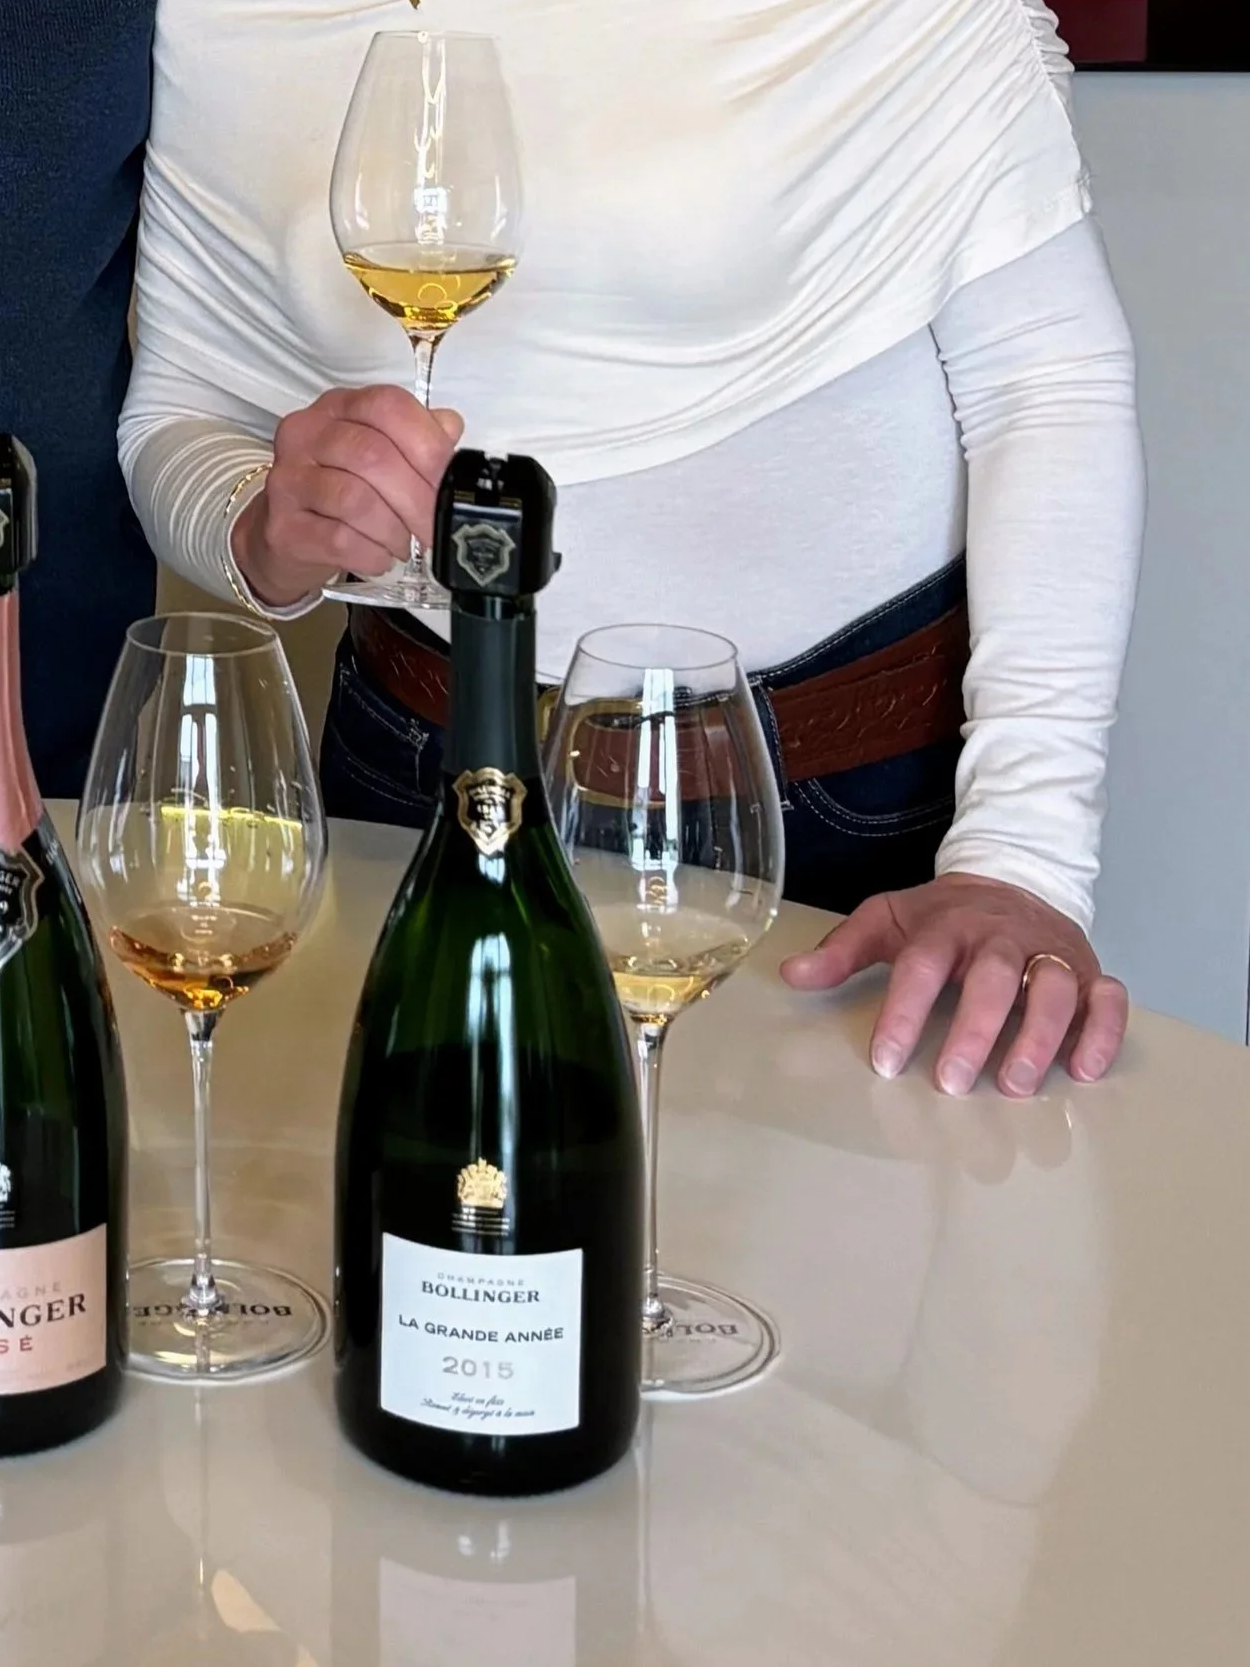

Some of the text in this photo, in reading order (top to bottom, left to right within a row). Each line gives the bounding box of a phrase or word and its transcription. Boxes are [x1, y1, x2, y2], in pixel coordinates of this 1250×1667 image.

[421, 1280, 540, 1304] BOLLINGER
[398, 1313, 564, 1343] LA GRANDE ANNÉE
[441, 1355, 515, 1380] 2015
